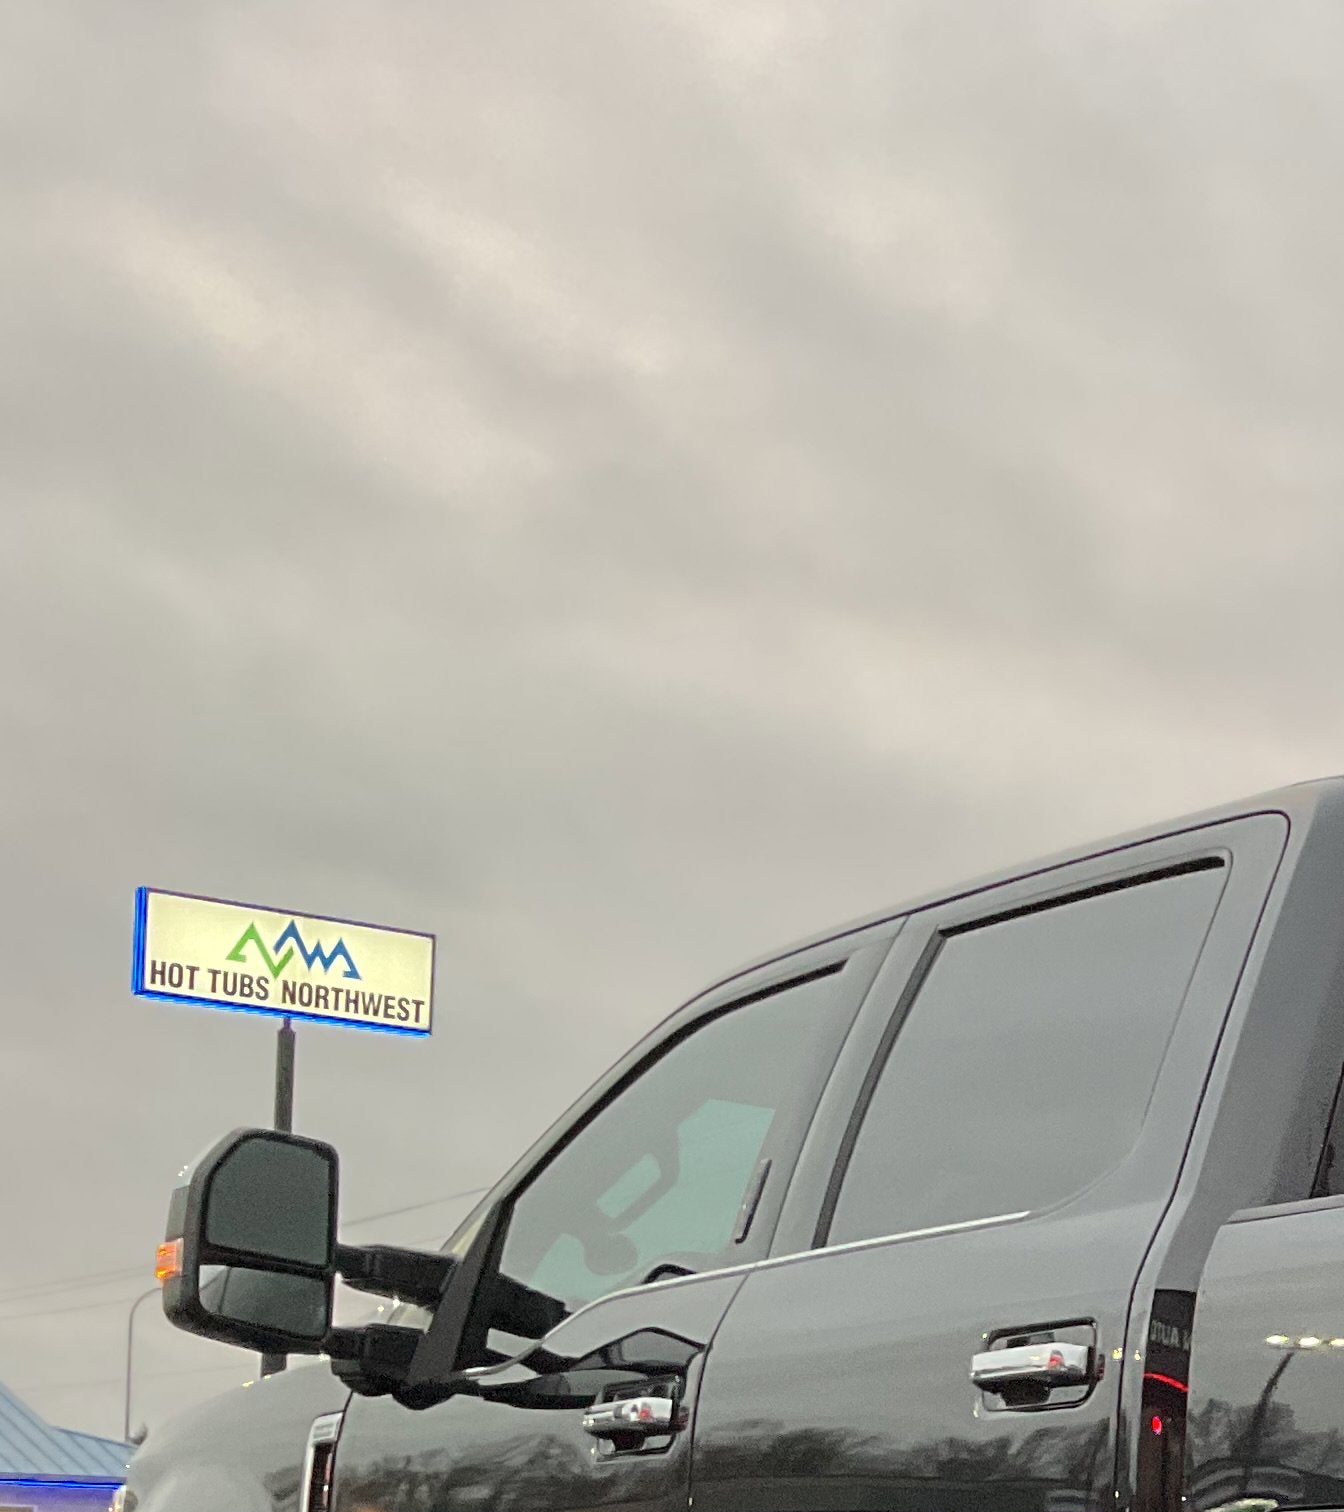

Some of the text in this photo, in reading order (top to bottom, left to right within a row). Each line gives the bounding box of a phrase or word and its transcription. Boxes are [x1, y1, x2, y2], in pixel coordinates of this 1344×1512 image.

[150, 959, 425, 1024] HOT TUBS NORTHWEST
